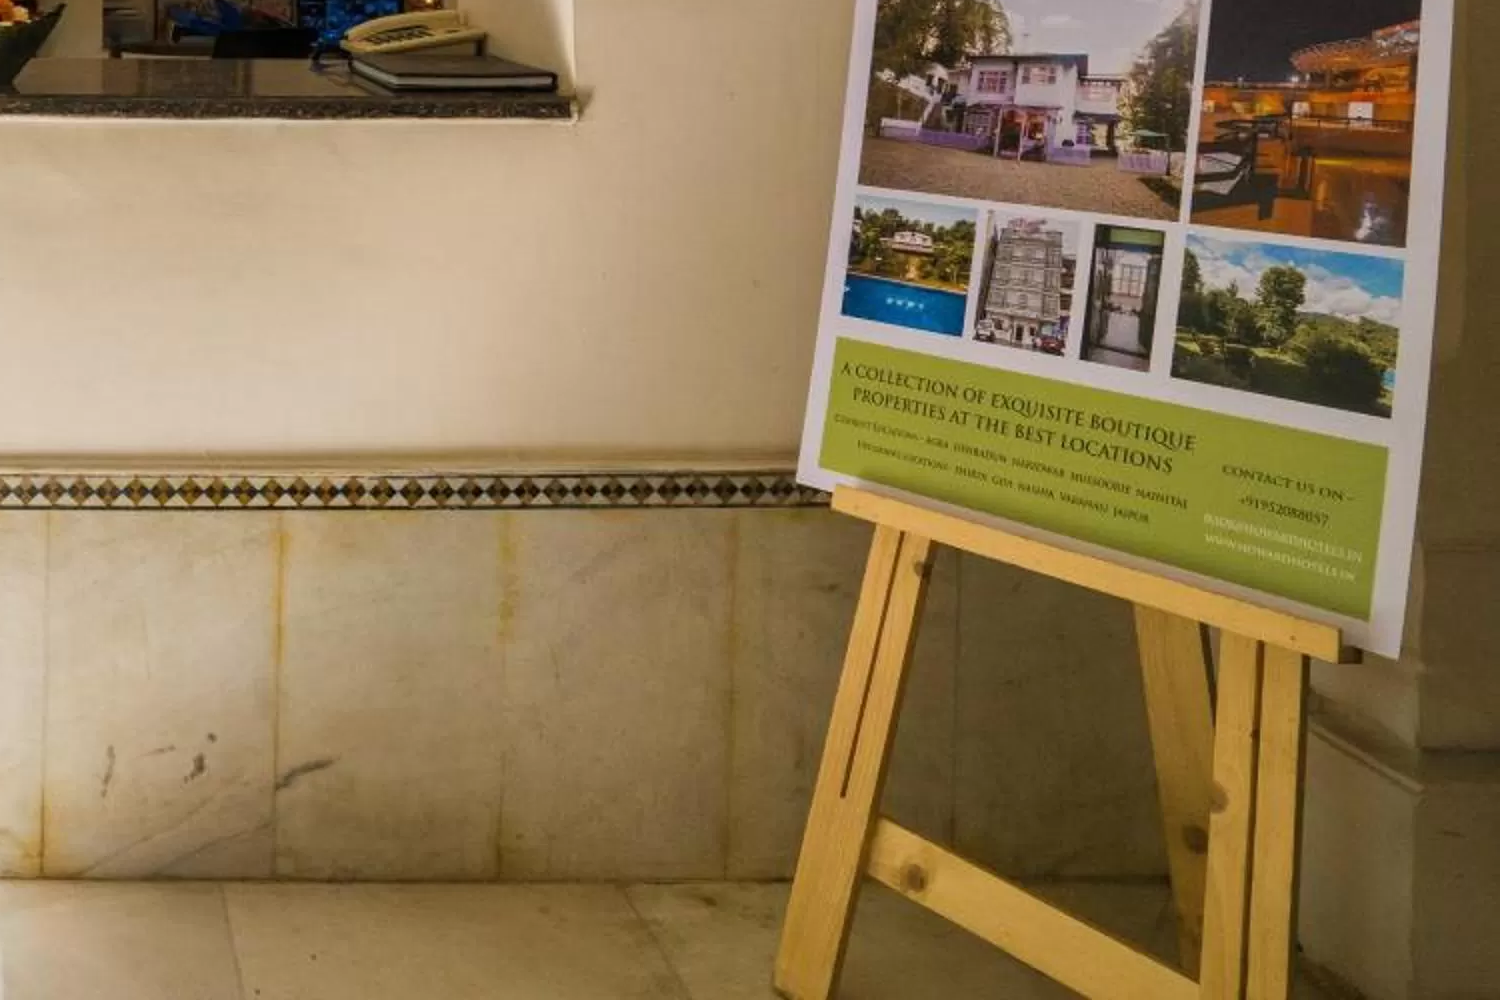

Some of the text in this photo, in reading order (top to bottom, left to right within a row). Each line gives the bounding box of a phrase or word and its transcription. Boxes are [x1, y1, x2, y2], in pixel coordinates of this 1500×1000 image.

[841, 361, 1197, 452] A COLLECTION OF EXQUISITE BOUTIQUE
[853, 387, 1173, 473] PROPERTIES AT THE BEST LOCATIONS
[1221, 464, 1294, 489] CONTACT
[1297, 481, 1315, 495] US
[1318, 487, 1344, 502] ON
